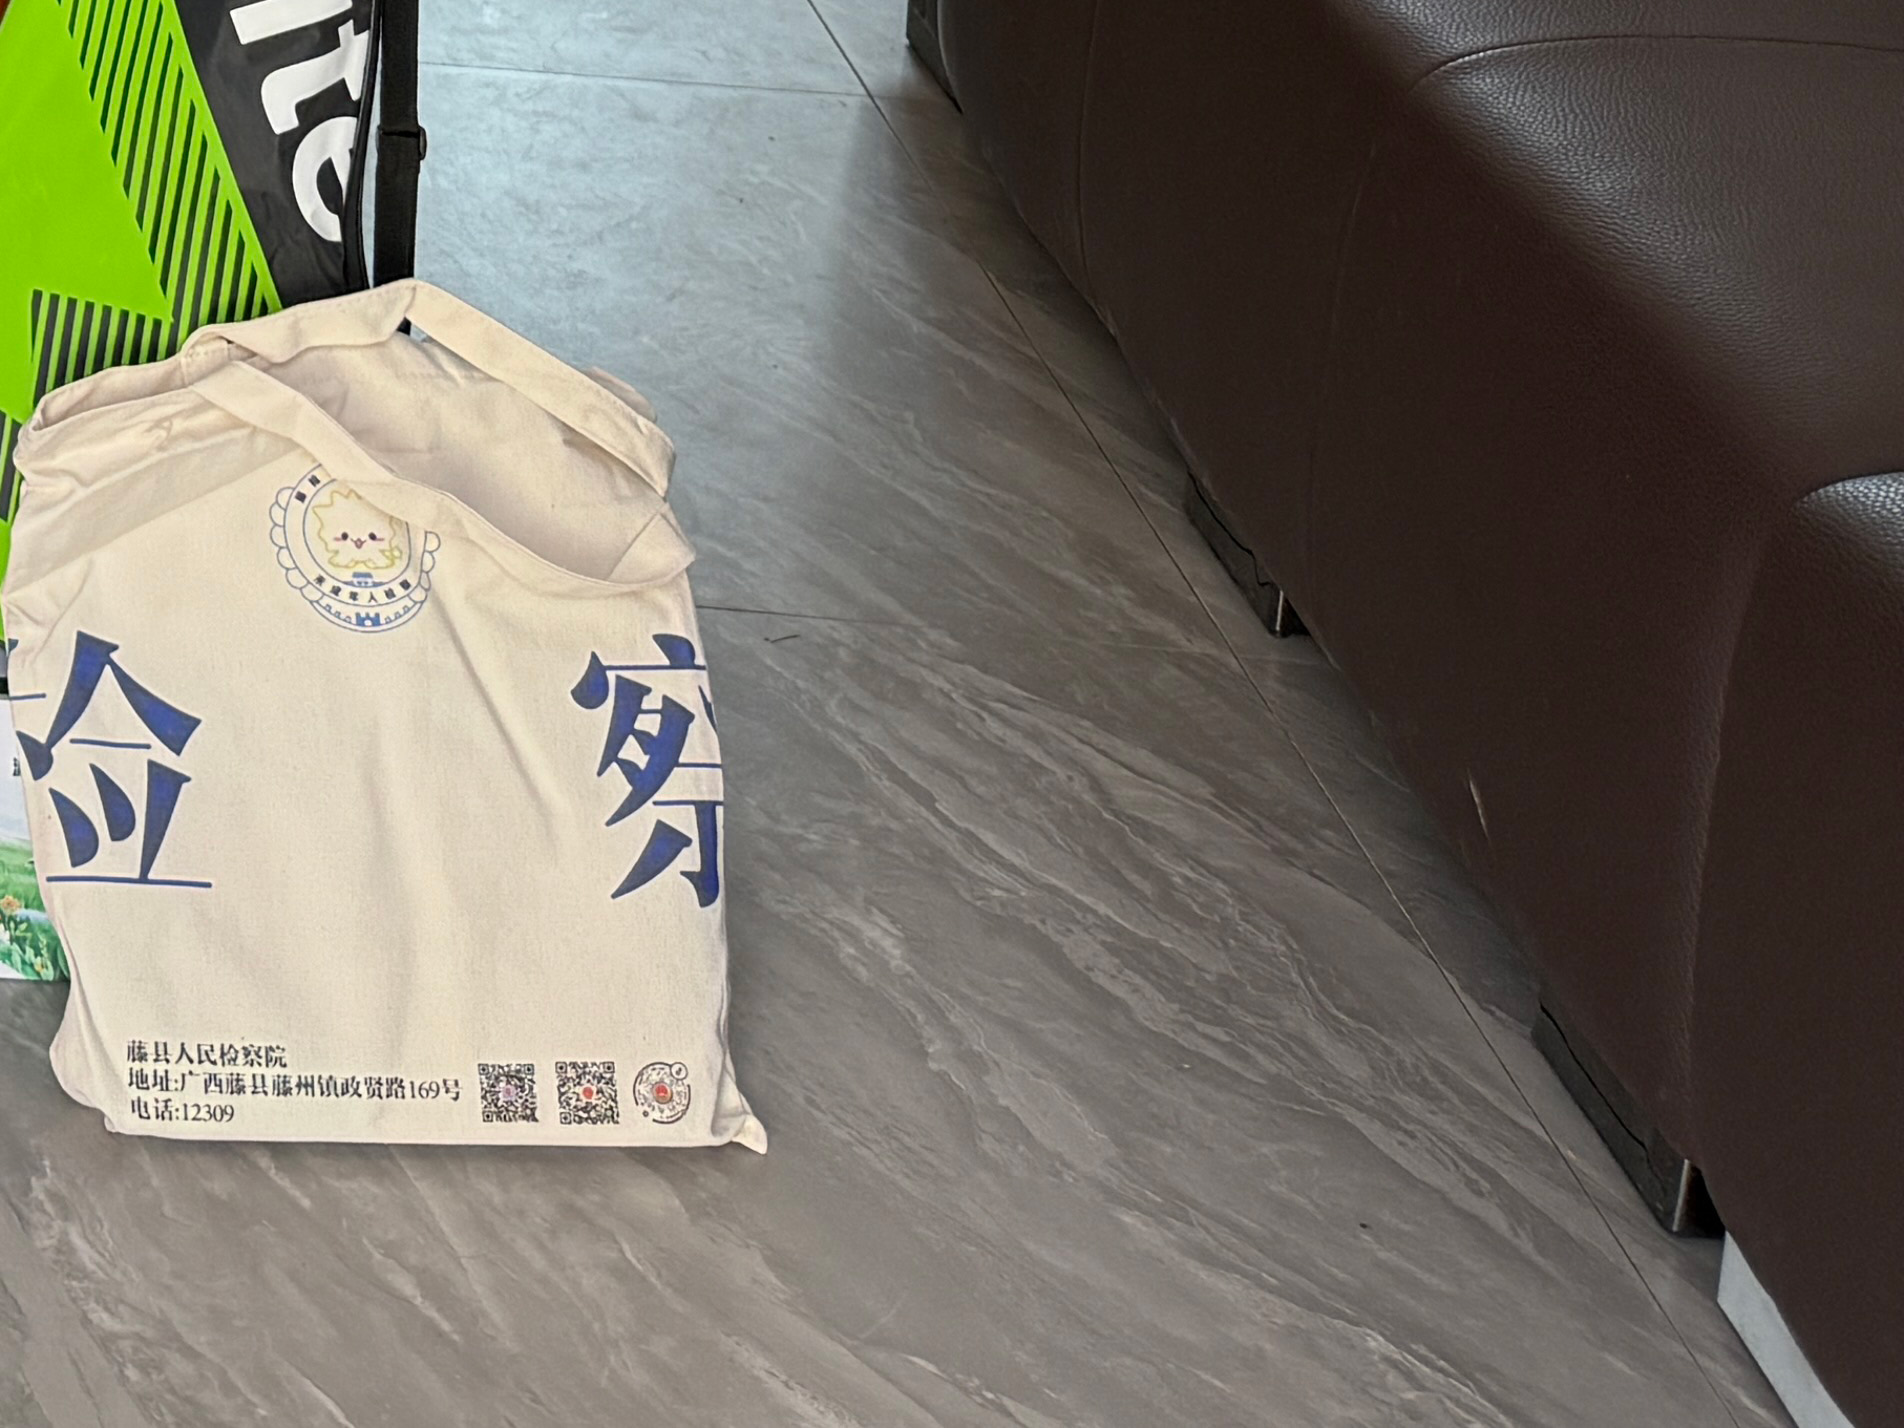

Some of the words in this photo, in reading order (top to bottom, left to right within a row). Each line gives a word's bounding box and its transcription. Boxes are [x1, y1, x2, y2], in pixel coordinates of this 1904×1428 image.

[127, 1040, 288, 1068] 藤县人民检察院
[131, 1095, 235, 1123] 电话:12309
